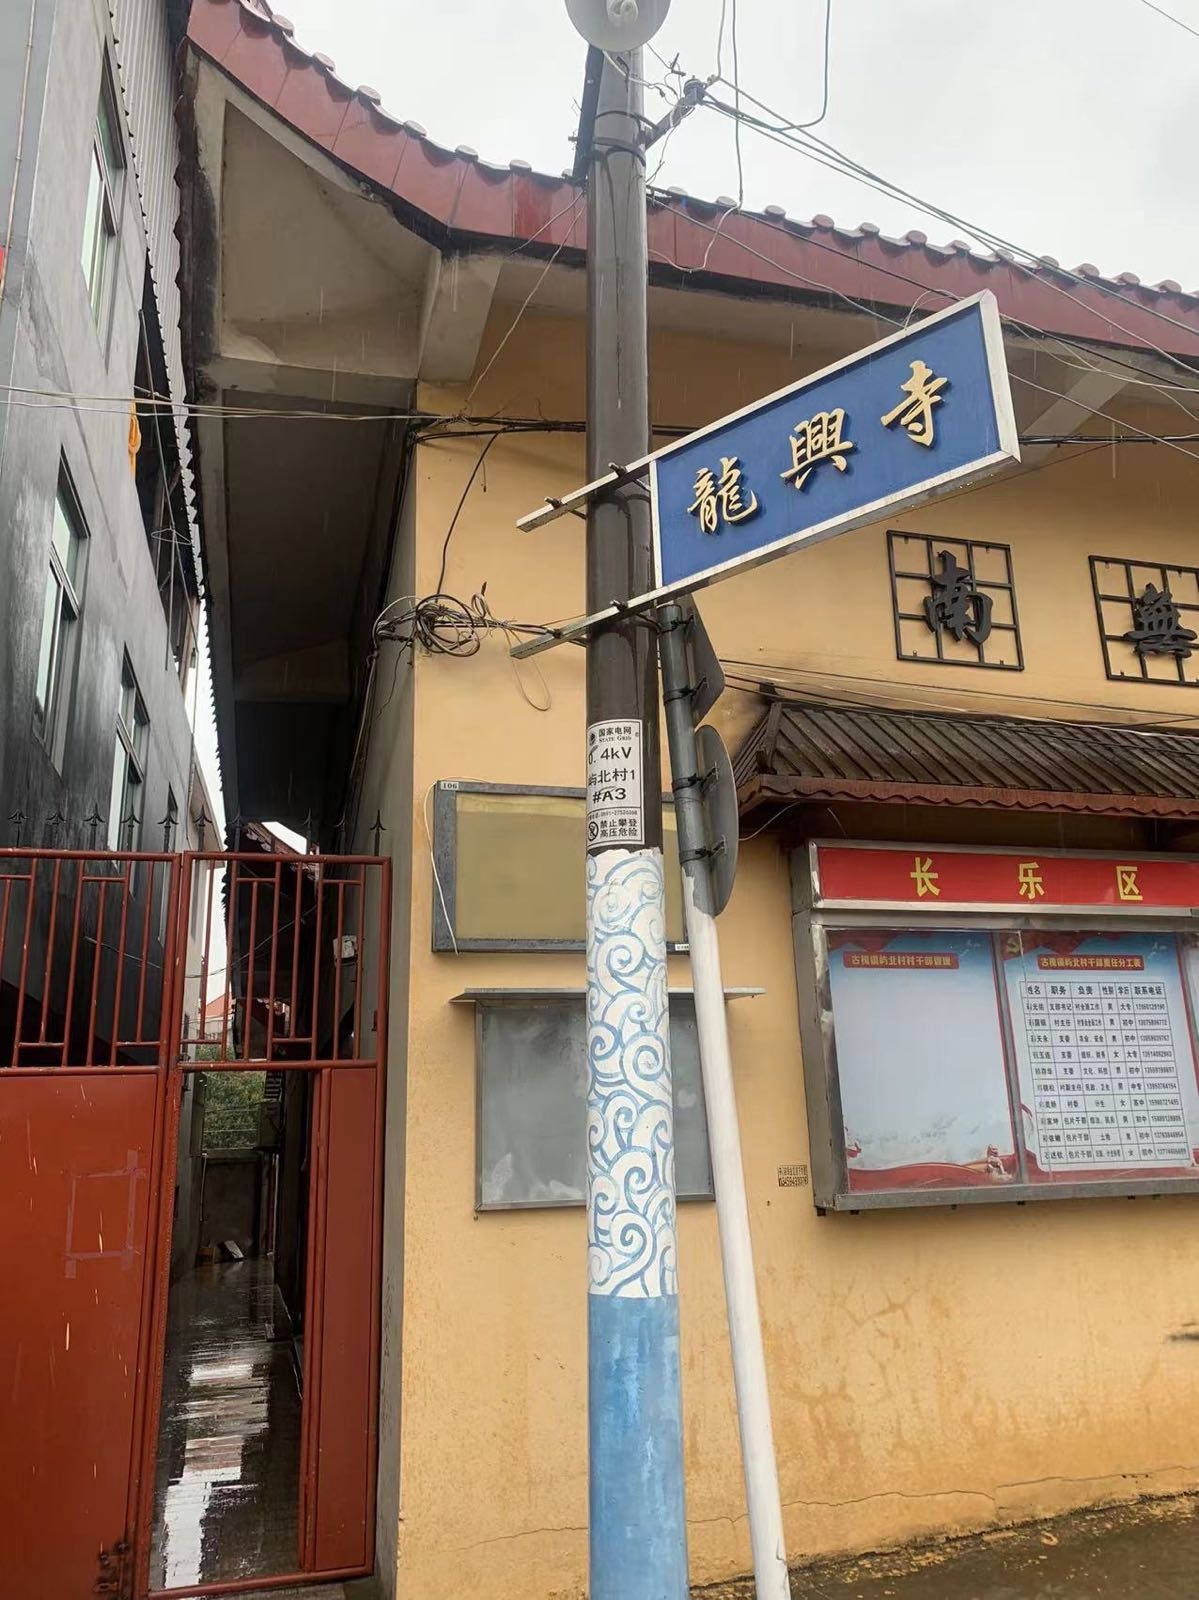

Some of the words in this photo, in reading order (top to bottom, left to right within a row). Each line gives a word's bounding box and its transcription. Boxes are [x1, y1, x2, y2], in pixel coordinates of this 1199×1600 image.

[688, 359, 948, 533] 龍興寺
[598, 726, 632, 738] 国家电网
[593, 788, 626, 803] #A3
[600, 819, 637, 828] 禁止攀登
[600, 828, 638, 838] 高压危险
[910, 856, 1143, 901] 长乐区
